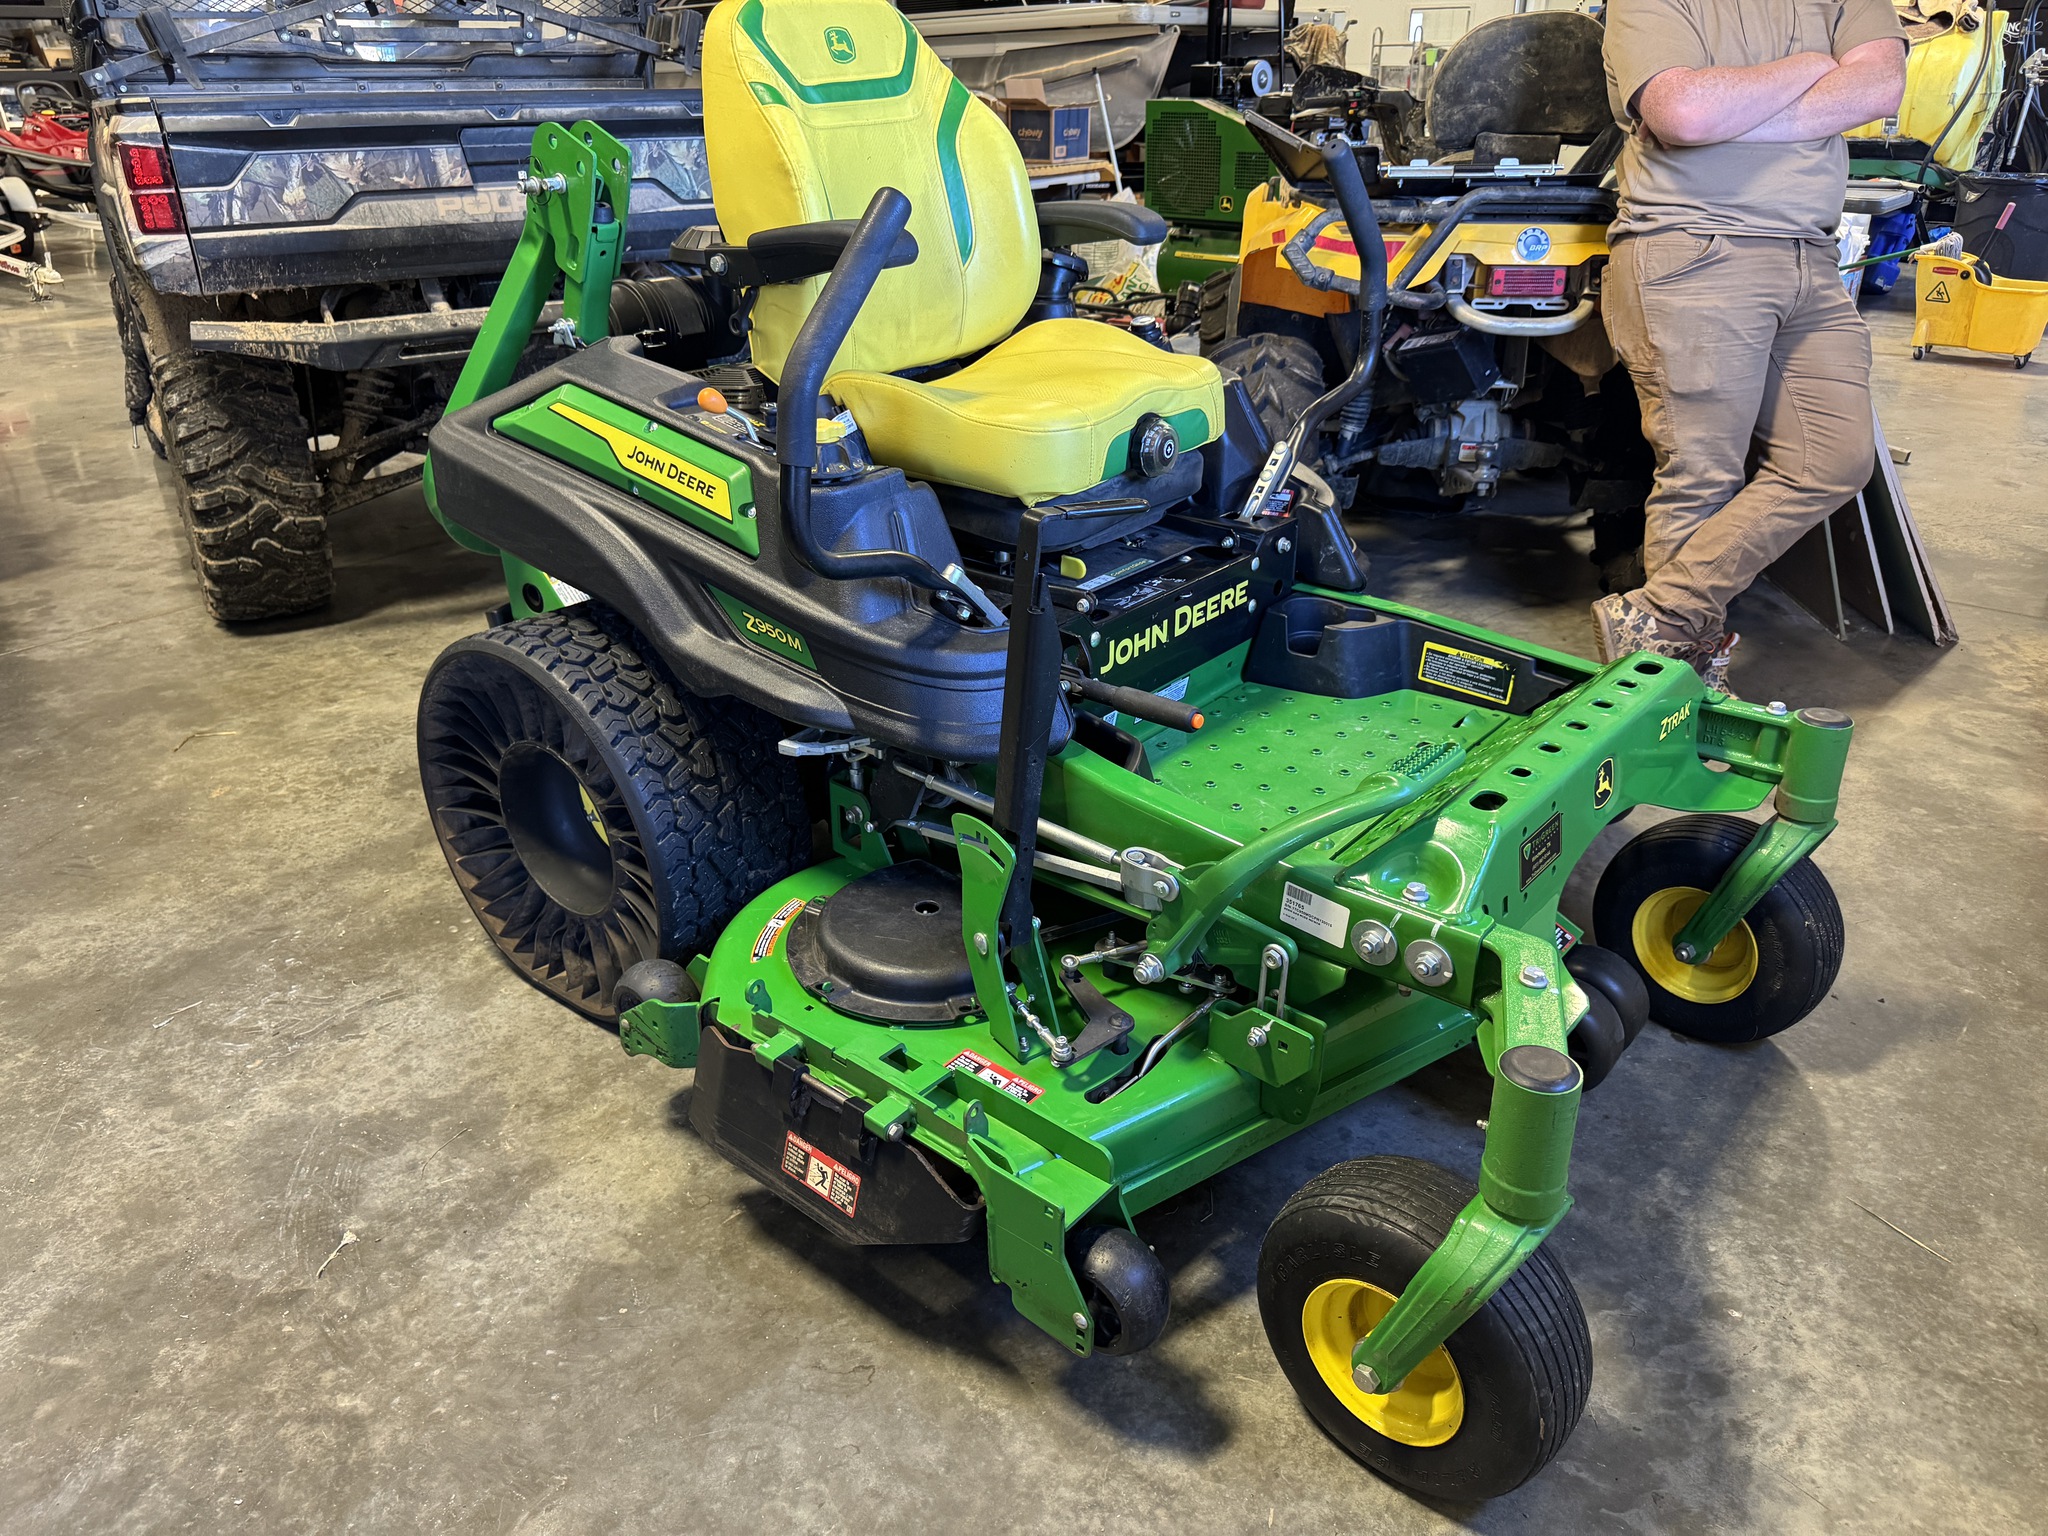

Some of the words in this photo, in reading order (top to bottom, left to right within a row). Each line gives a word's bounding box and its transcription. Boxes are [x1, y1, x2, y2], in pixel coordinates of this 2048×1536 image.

[1018, 128, 1043, 138] chewy
[1063, 128, 1081, 137] chewy
[627, 446, 665, 474] JOHN
[667, 463, 716, 499] DEERE
[742, 611, 802, 652] Z950M
[1100, 618, 1168, 675] JOHN
[1174, 580, 1249, 637] DEERE
[1659, 699, 1692, 741] ZTRAK
[1286, 898, 1305, 910] 351765
[968, 1051, 992, 1067] DANGER
[1019, 1079, 1043, 1095] PELIGRO
[793, 1134, 813, 1154] DANGER
[838, 1165, 860, 1185] PELIGRO
[1277, 1241, 1381, 1281] CARLISLE
